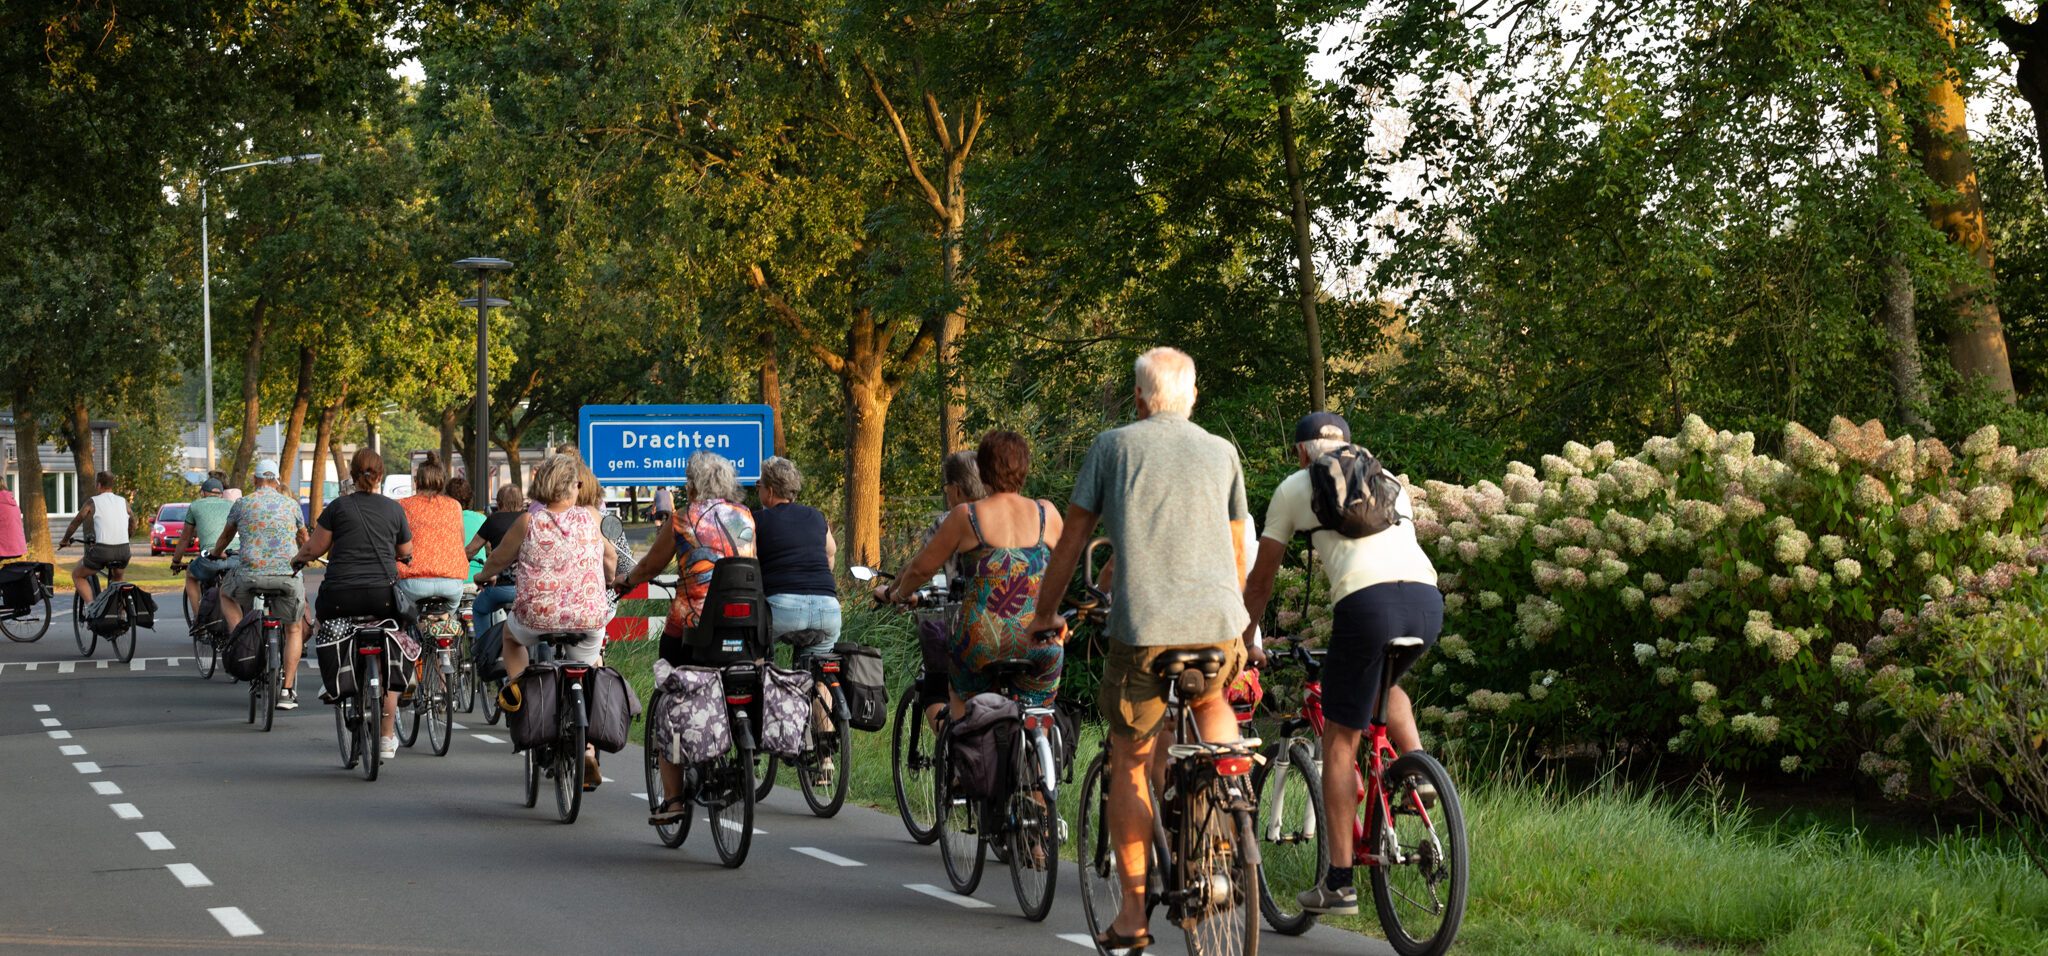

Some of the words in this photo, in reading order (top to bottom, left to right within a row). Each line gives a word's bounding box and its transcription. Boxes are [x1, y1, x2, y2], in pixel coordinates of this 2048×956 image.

[622, 430, 730, 449] Drachten
[608, 458, 639, 472] gem.
[643, 457, 745, 469] Smallind
